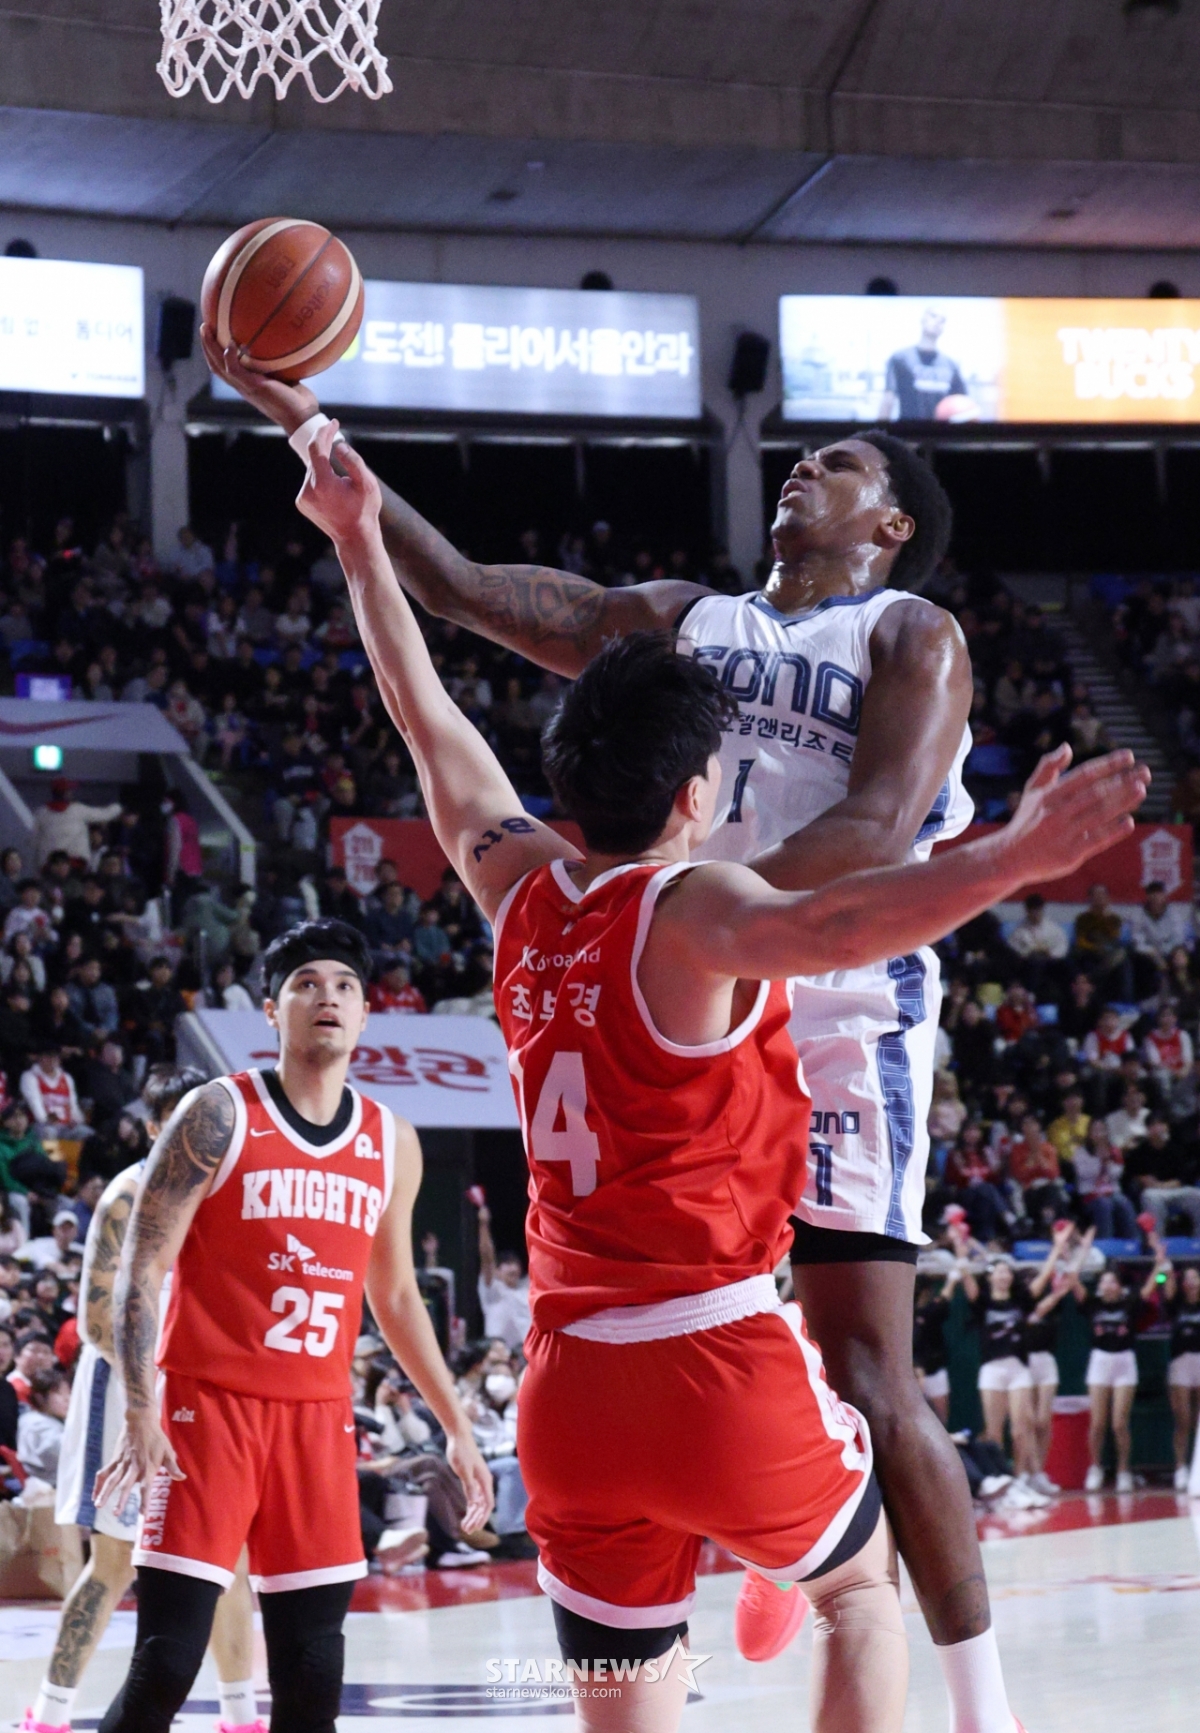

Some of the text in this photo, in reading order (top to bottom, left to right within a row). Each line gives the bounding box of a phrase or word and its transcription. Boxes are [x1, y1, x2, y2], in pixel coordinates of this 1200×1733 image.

[1074, 361, 1195, 399] BUCKS
[722, 713, 854, 764] 텔앤리조트
[241, 1168, 383, 1237] KNIGHTS
[809, 1142, 834, 1206] 1
[267, 1252, 354, 1281] SK telecom
[264, 1285, 345, 1358] 25
[142, 1466, 172, 1546] RSHEY'S
